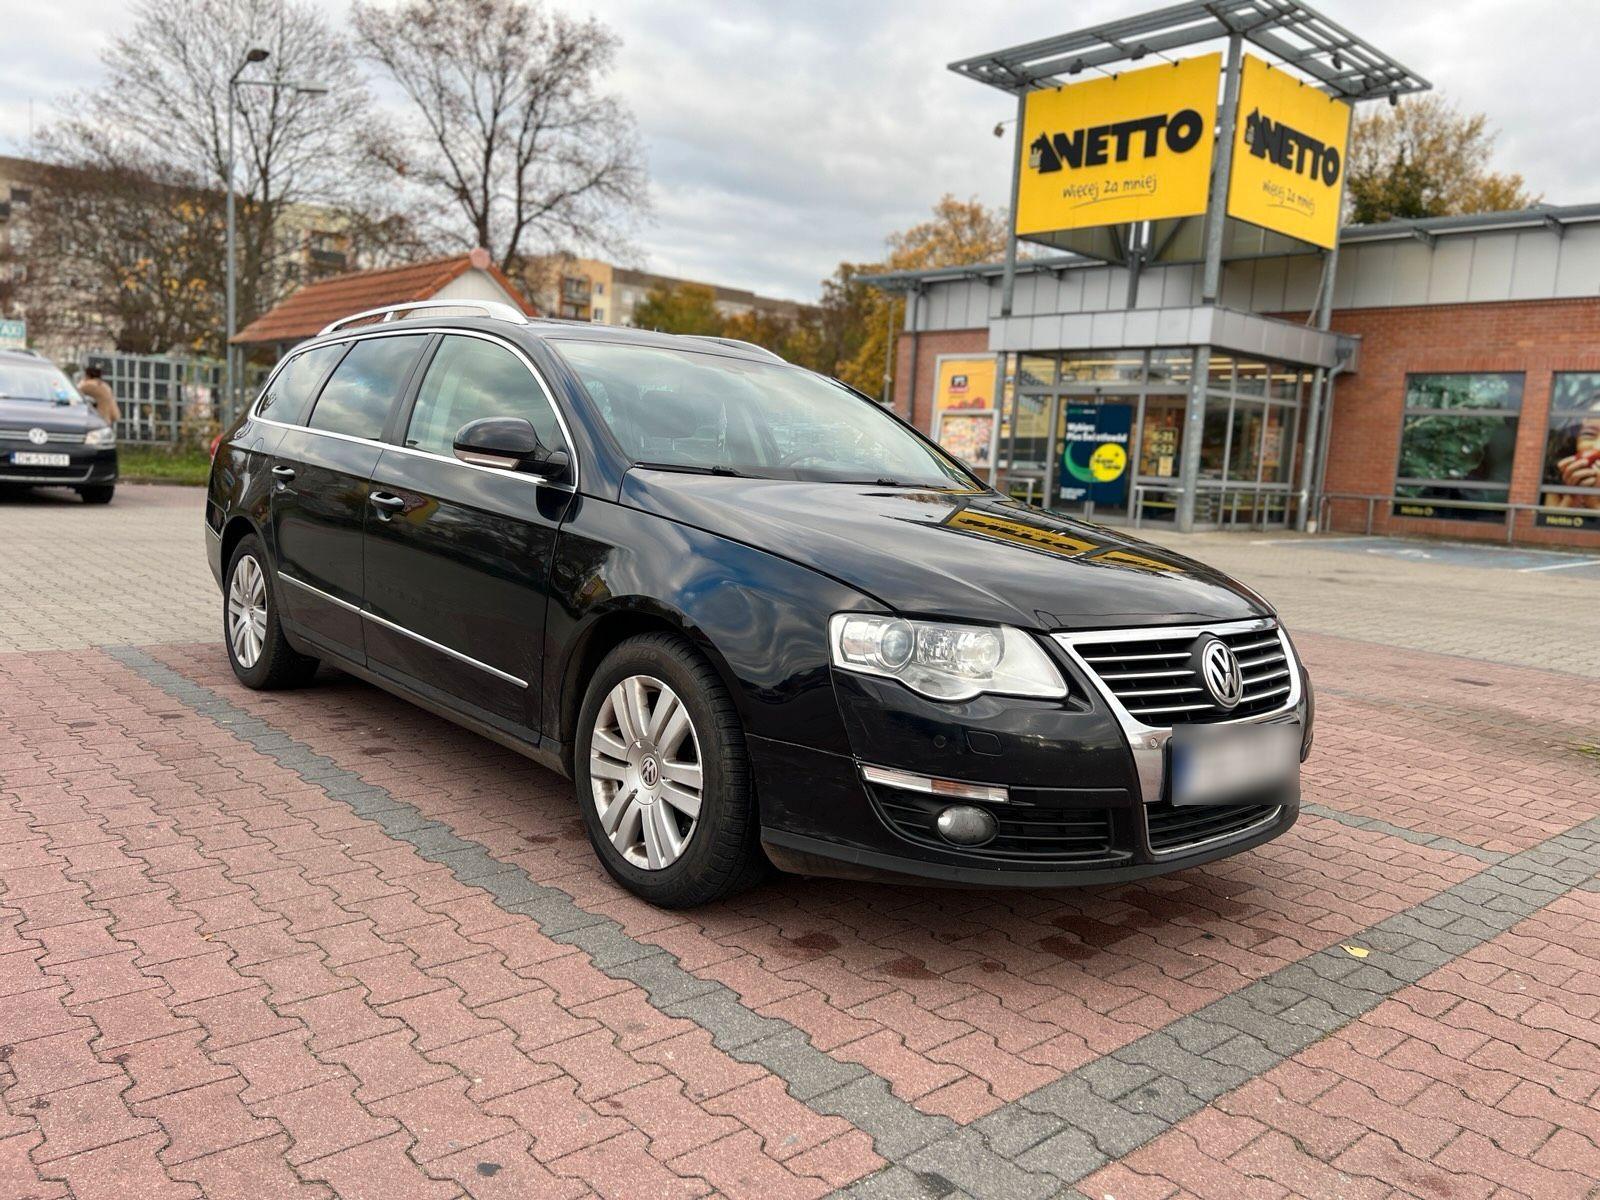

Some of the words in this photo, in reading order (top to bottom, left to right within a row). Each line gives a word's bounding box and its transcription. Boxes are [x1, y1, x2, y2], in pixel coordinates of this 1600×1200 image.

[1047, 108, 1204, 169] NETTO
[1260, 116, 1341, 187] NETTO
[1122, 174, 1158, 194] mniej
[1546, 516, 1573, 526] Netto
